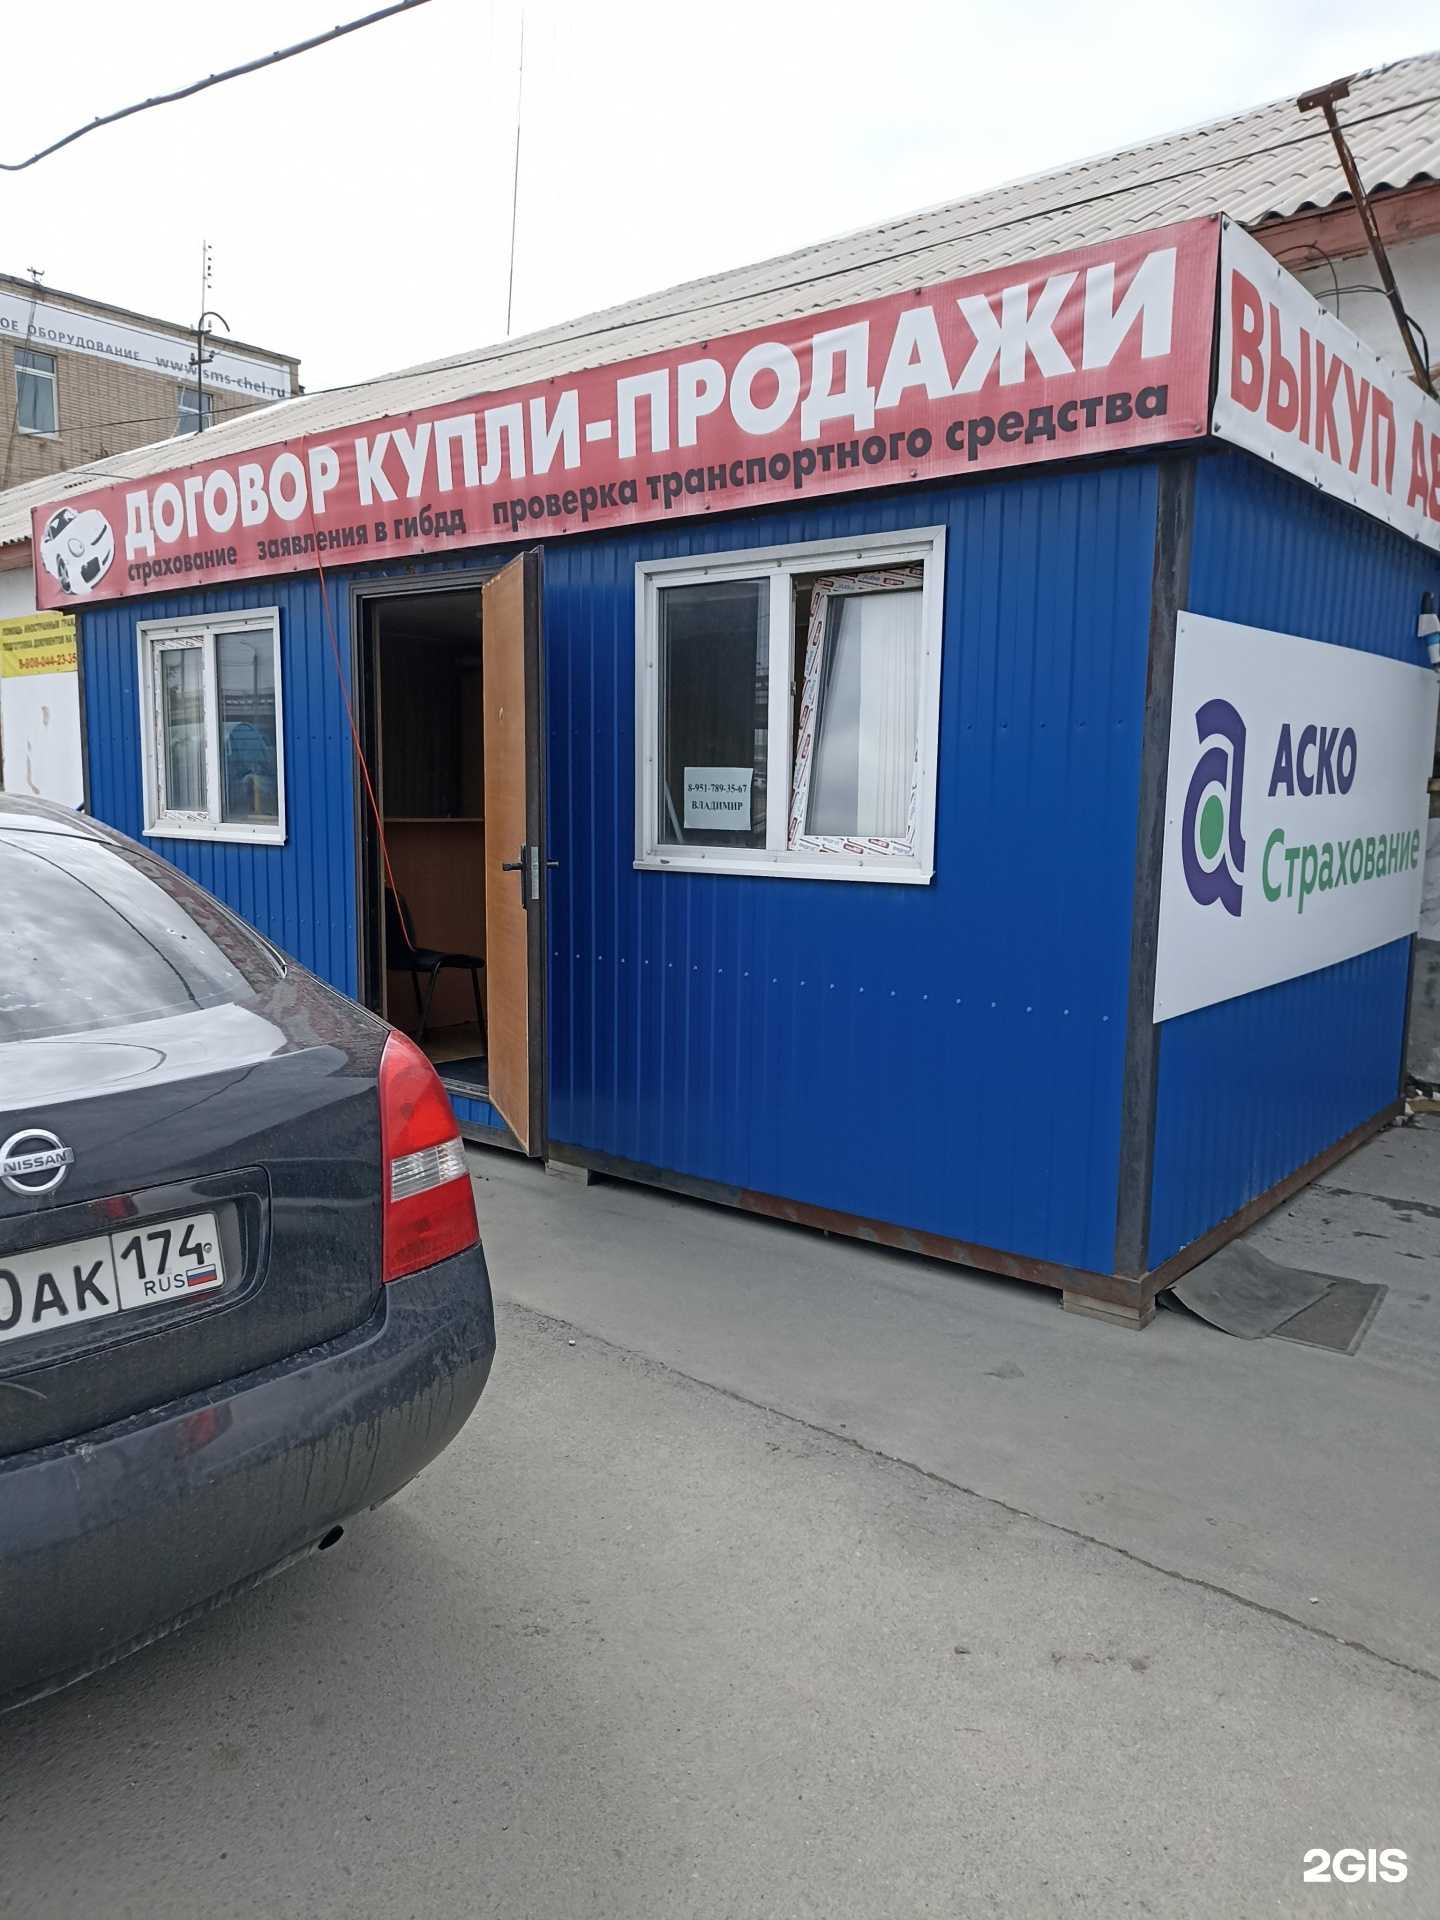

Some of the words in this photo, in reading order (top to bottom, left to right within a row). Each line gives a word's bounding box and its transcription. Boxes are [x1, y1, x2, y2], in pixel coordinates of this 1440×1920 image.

[27, 324, 140, 361] ОБОРУДОВАНИЕ
[124, 446, 341, 561] ДОГОВОР
[355, 247, 1177, 506] КУПЛИ-ПРОДАЖИ
[1230, 268, 1396, 496] ВЫКУП
[127, 545, 238, 585] страхование
[257, 522, 368, 561] заявления
[375, 521, 388, 543] в
[394, 504, 466, 540] гибдд
[493, 479, 638, 532] проверка
[646, 427, 933, 509] транспортного
[945, 384, 1169, 461] средства
[687, 783, 747, 793] 8-951-789-35-67
[1268, 723, 1358, 797] АСКО
[691, 800, 743, 811] ВЛАДИМИР
[1261, 827, 1420, 914] Страхование
[3, 1153, 67, 1173] NISSAN
[120, 1223, 205, 1280] 174
[144, 1273, 186, 1296] RUS
